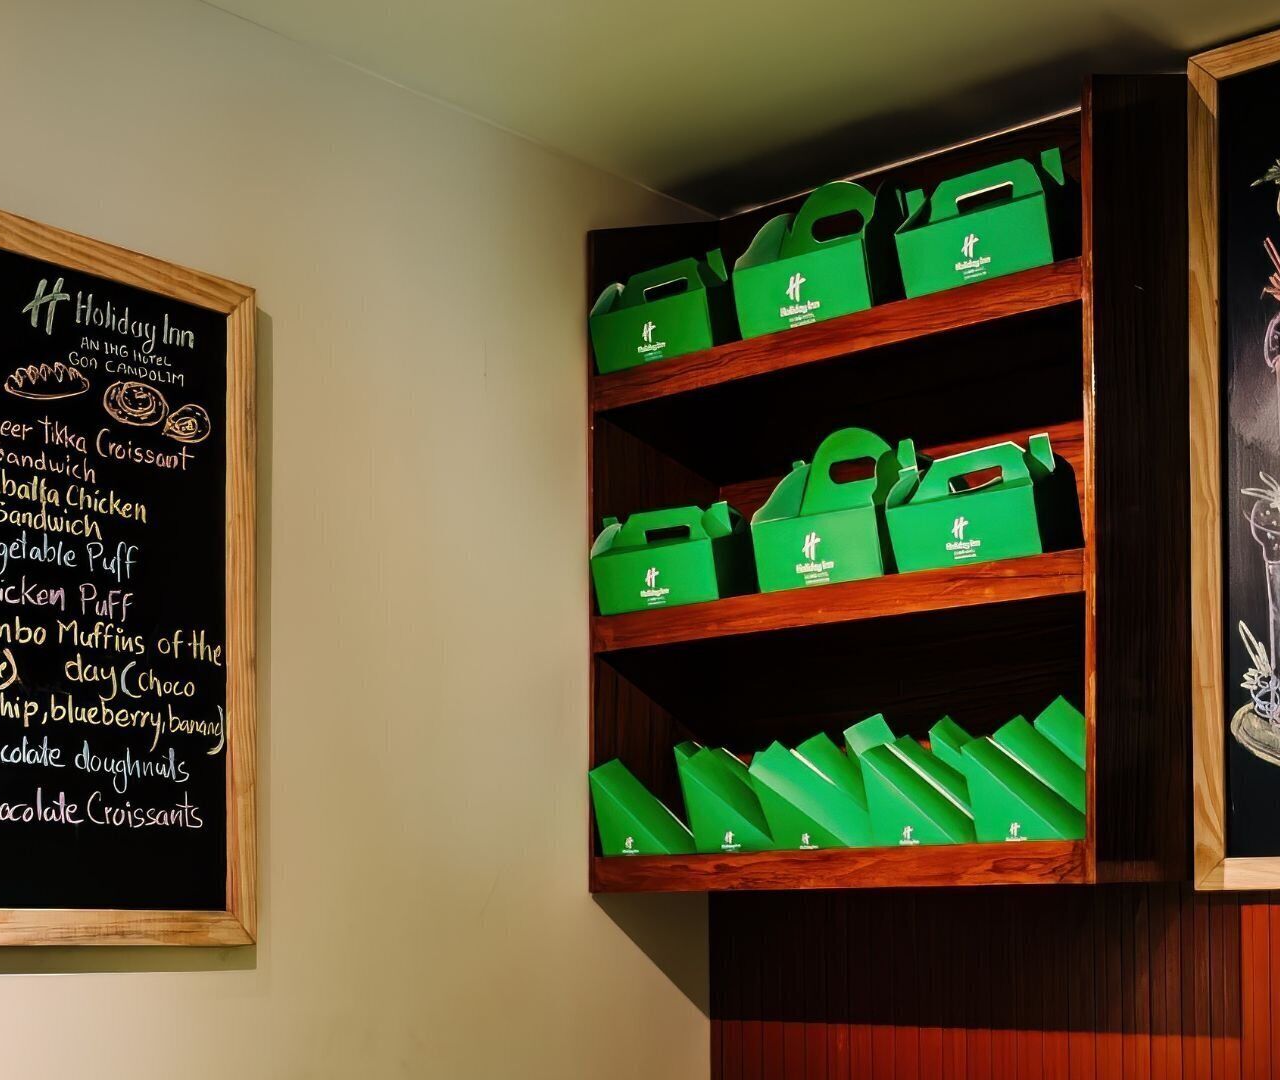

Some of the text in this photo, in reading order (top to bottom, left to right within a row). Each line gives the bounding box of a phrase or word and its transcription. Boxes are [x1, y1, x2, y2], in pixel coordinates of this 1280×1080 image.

[76, 291, 194, 354] Holiday Inn
[81, 337, 100, 350] AN
[96, 429, 195, 470] Croissant
[66, 485, 146, 523] Chicken
[87, 541, 138, 582] Puff
[58, 620, 144, 654] Muffins
[158, 630, 183, 658] of
[188, 630, 222, 666] the
[66, 653, 117, 702] day
[75, 740, 189, 793] doughnuts
[87, 791, 203, 828] Croissants
